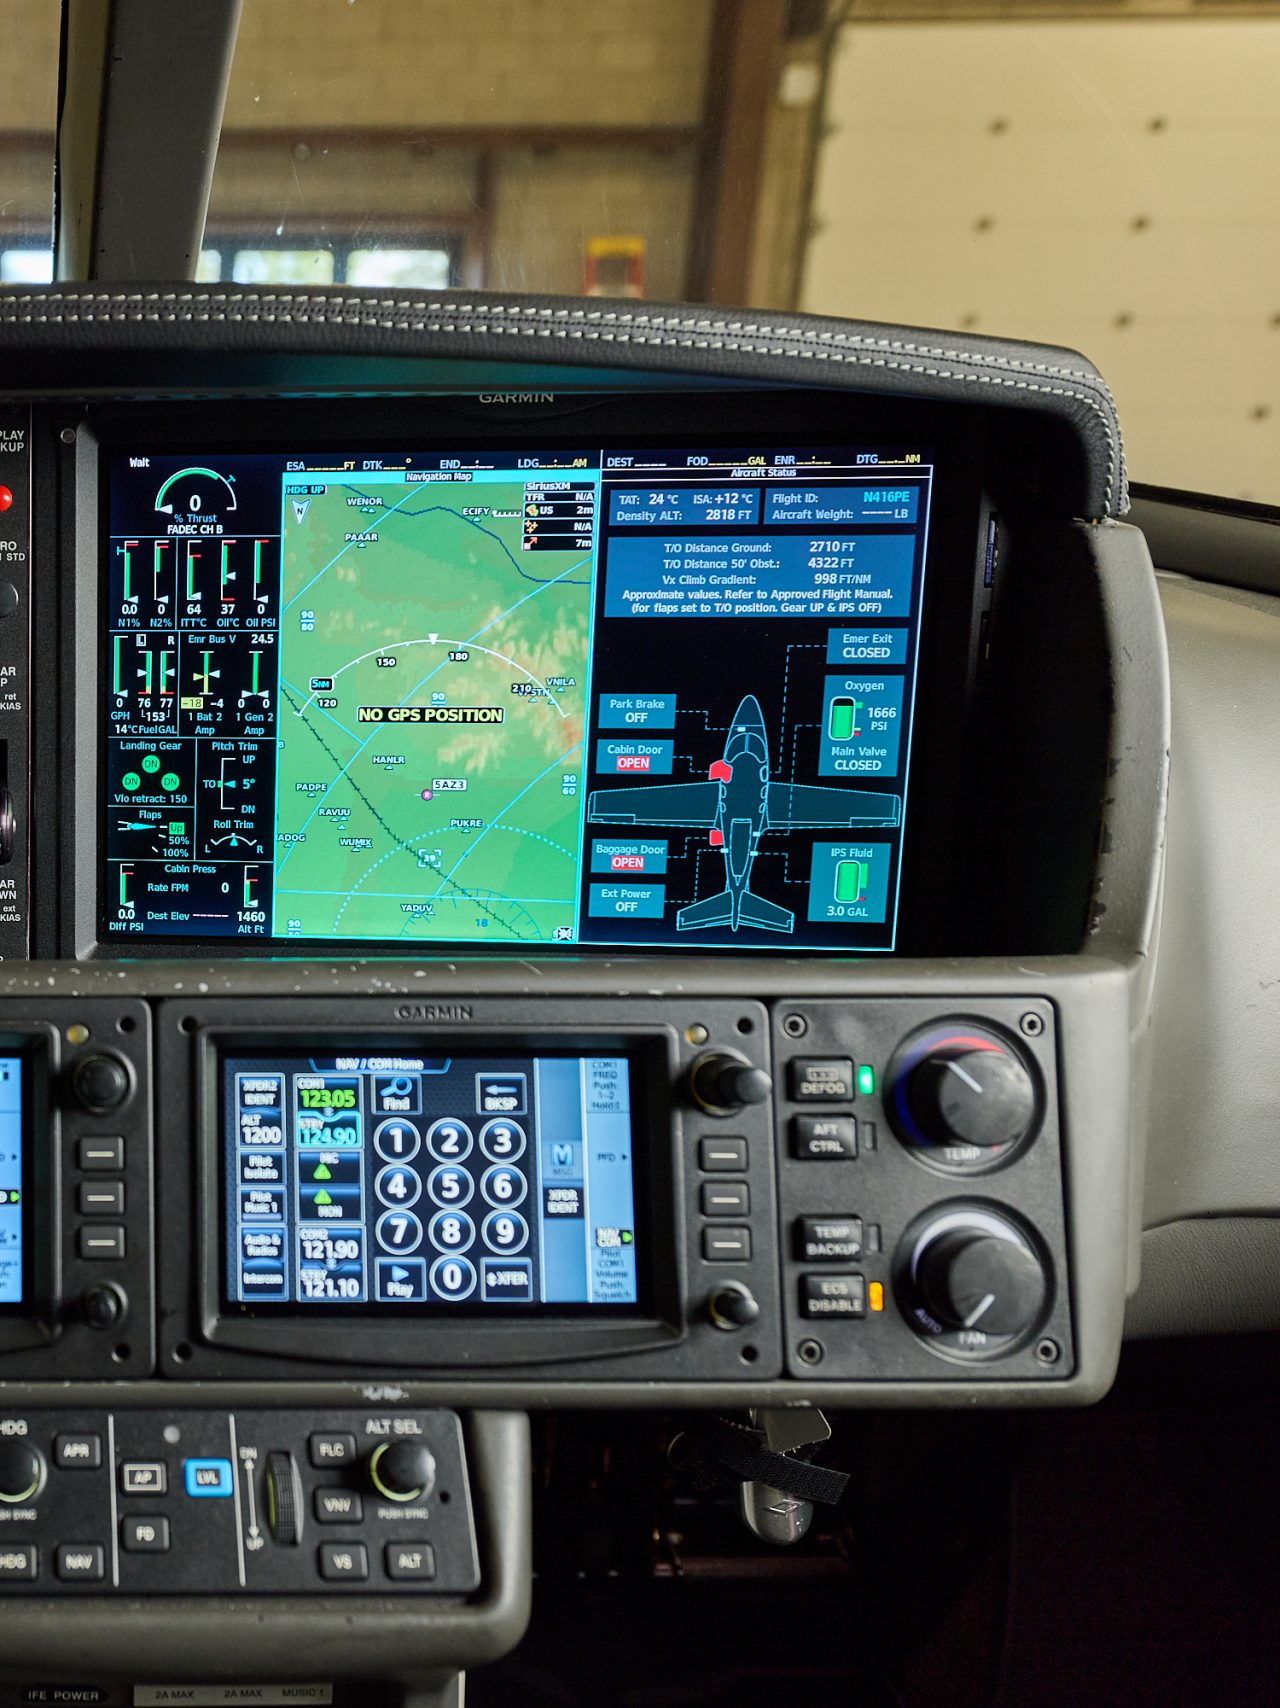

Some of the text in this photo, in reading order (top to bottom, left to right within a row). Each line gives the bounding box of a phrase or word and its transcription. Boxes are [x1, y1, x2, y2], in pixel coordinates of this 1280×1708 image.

[479, 392, 553, 403] GARMIN
[130, 458, 150, 467] Wait
[407, 472, 472, 482] Navigation Map
[731, 468, 796, 477] Aircraft Status
[526, 482, 570, 490] SiriusXM
[347, 497, 383, 506] WENOR
[773, 491, 910, 505] Flight ID: N416PE
[773, 509, 853, 521] Aircraft Weight:
[664, 543, 772, 553] T/O Distance Ground:
[7, 553, 25, 561] STD
[623, 589, 893, 601] Approximate values. Refer to Approved Flight Manual.
[252, 634, 274, 643] 24.5
[843, 648, 890, 658] CLOSED
[845, 681, 884, 693] Oxygen
[610, 699, 664, 709] Park Brake
[359, 709, 503, 721] NO GPS POSITION
[120, 742, 181, 751] Landing Gear
[212, 742, 257, 751] Pitch Trim
[608, 745, 663, 755] Cabin Door
[832, 747, 886, 756] Main Valve
[373, 756, 405, 764] HANLR
[618, 758, 649, 769] OPEN
[835, 760, 881, 771] CLOSED
[296, 783, 327, 791] PADPE
[139, 810, 161, 820] Flaps
[319, 808, 350, 816] RAVUU
[214, 820, 253, 829] Roll Trim
[451, 819, 482, 827] PUKRE
[340, 838, 372, 846] WUMIX
[163, 849, 188, 857] 100%
[596, 845, 665, 857] Baggage Door
[165, 865, 216, 873] Cabin Press
[401, 904, 432, 912] YADUV
[147, 912, 190, 920] Dest Elev
[237, 912, 265, 922] 1460
[395, 1006, 473, 1019] GARMIN
[300, 1090, 356, 1108] 123.05
[243, 1126, 281, 1144] 1200
[302, 1128, 356, 1144] 124.90
[441, 1128, 458, 1152] 2
[390, 1128, 403, 1153] 1
[944, 1148, 980, 1160] TEMP
[303, 1241, 358, 1258] 121.90
[807, 1244, 859, 1255] BACKUP
[304, 1280, 359, 1298] 121.10
[366, 1420, 422, 1435] ALT SEL
[66, 1555, 92, 1569] NAV
